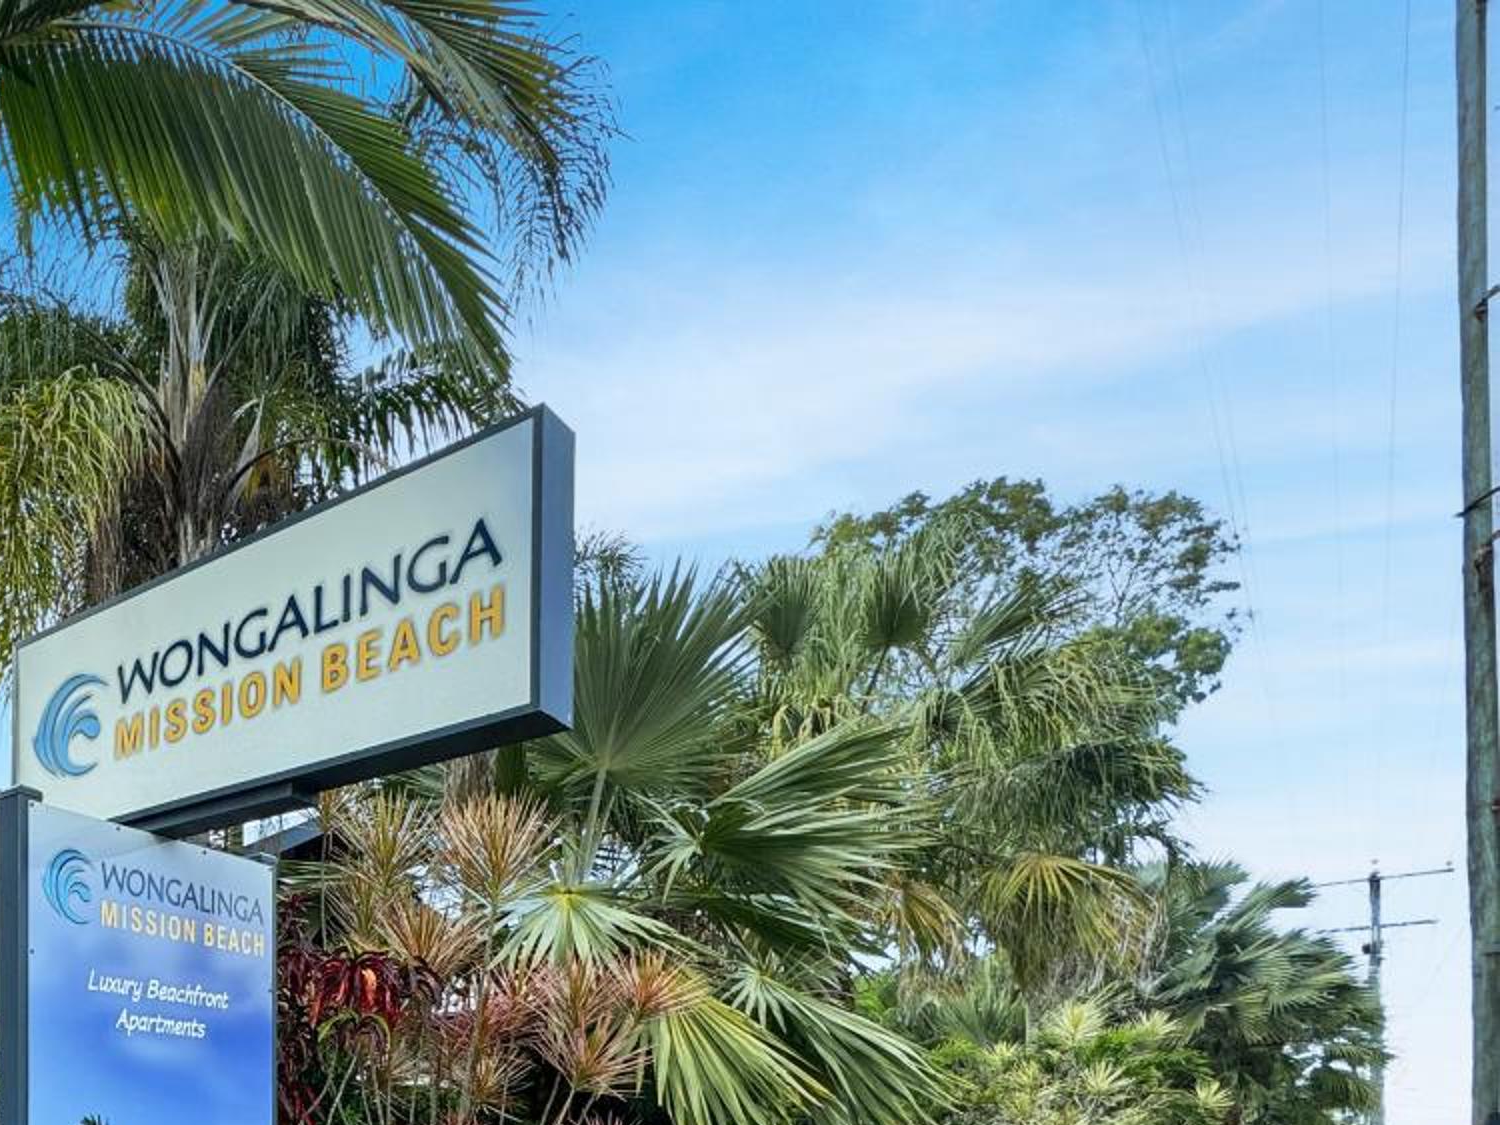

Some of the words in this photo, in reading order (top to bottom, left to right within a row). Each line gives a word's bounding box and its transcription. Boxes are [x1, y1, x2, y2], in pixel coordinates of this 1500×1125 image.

[117, 516, 503, 705] WONGALINGA
[113, 660, 302, 761] MISSION
[321, 583, 507, 694] BEACH
[101, 861, 264, 925] WONGALINGA
[100, 900, 196, 944] MISSION
[204, 923, 265, 958] BEACH
[88, 968, 143, 1002] Luxury
[147, 979, 229, 1009] Beachfront
[116, 1009, 206, 1039] Apartments
